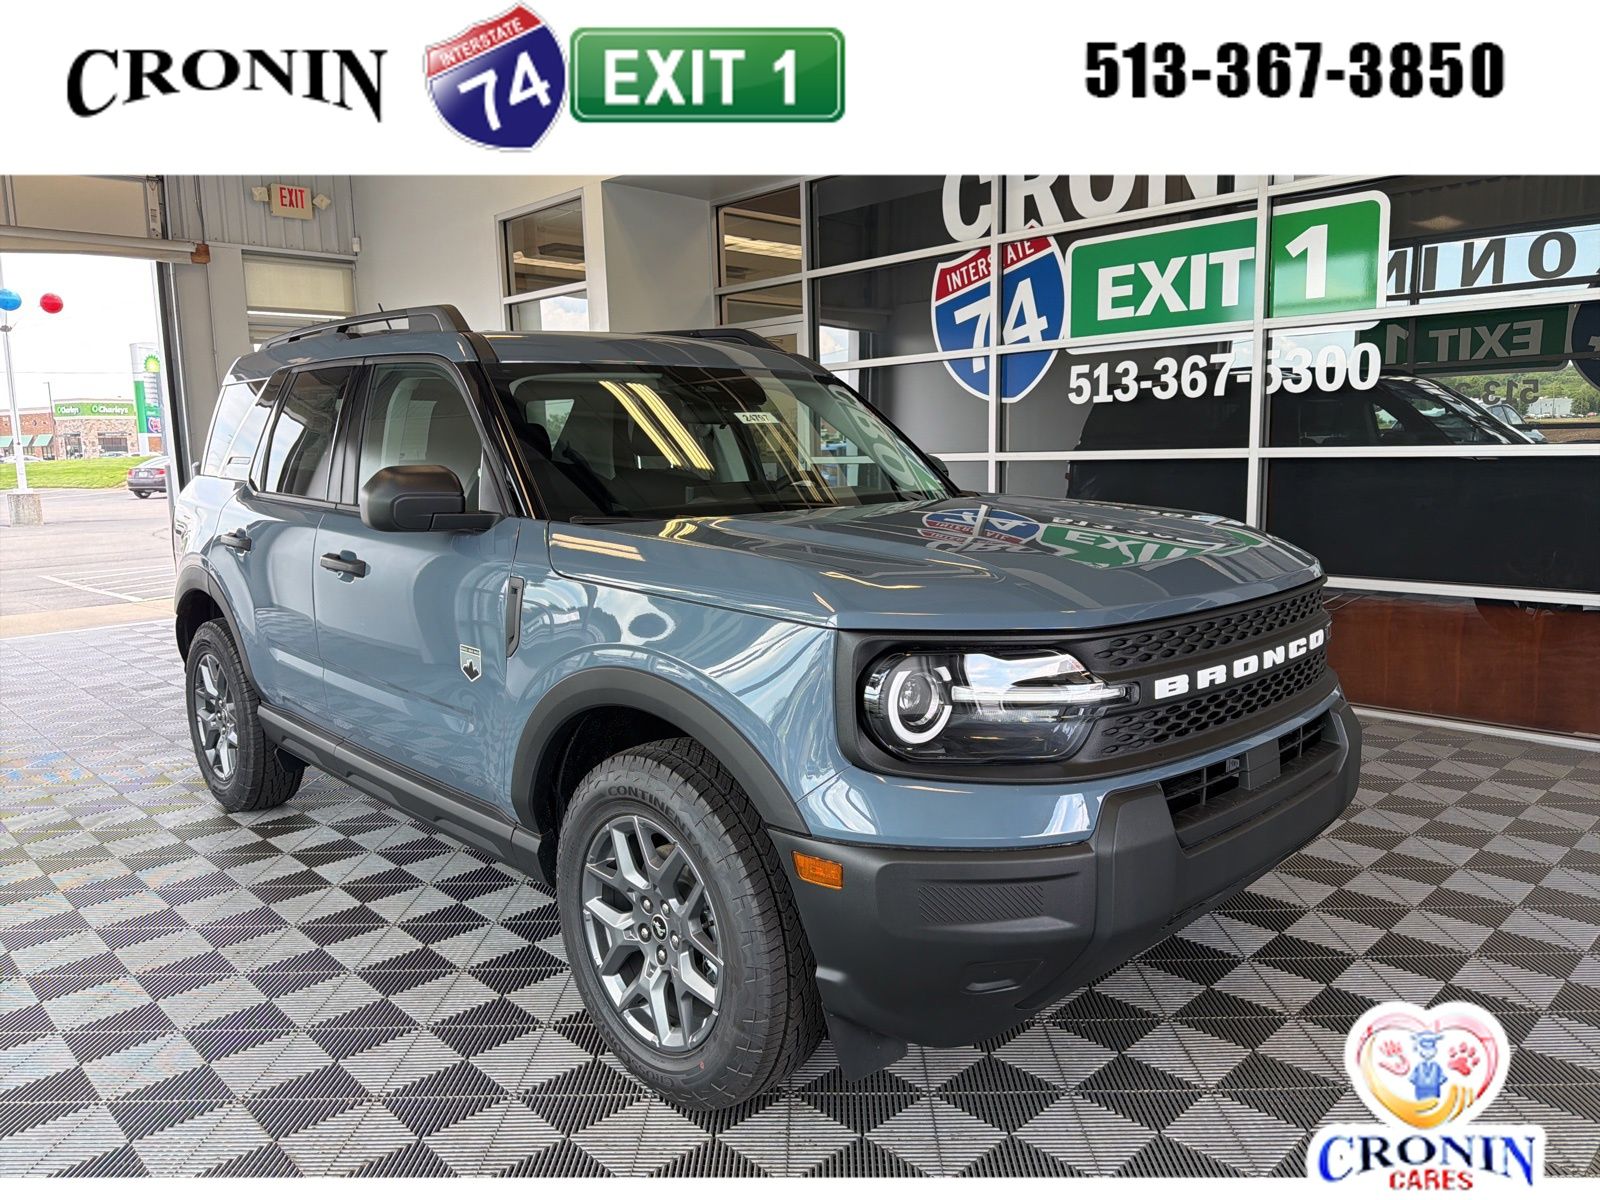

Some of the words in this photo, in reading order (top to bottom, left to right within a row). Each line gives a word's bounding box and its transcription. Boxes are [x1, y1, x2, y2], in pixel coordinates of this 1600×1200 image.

[280, 187, 304, 209] EXIT
[1097, 246, 1255, 321] EXIT
[1285, 223, 1328, 300] 1
[953, 277, 1048, 374] 74
[1154, 628, 1324, 700] BRONCO
